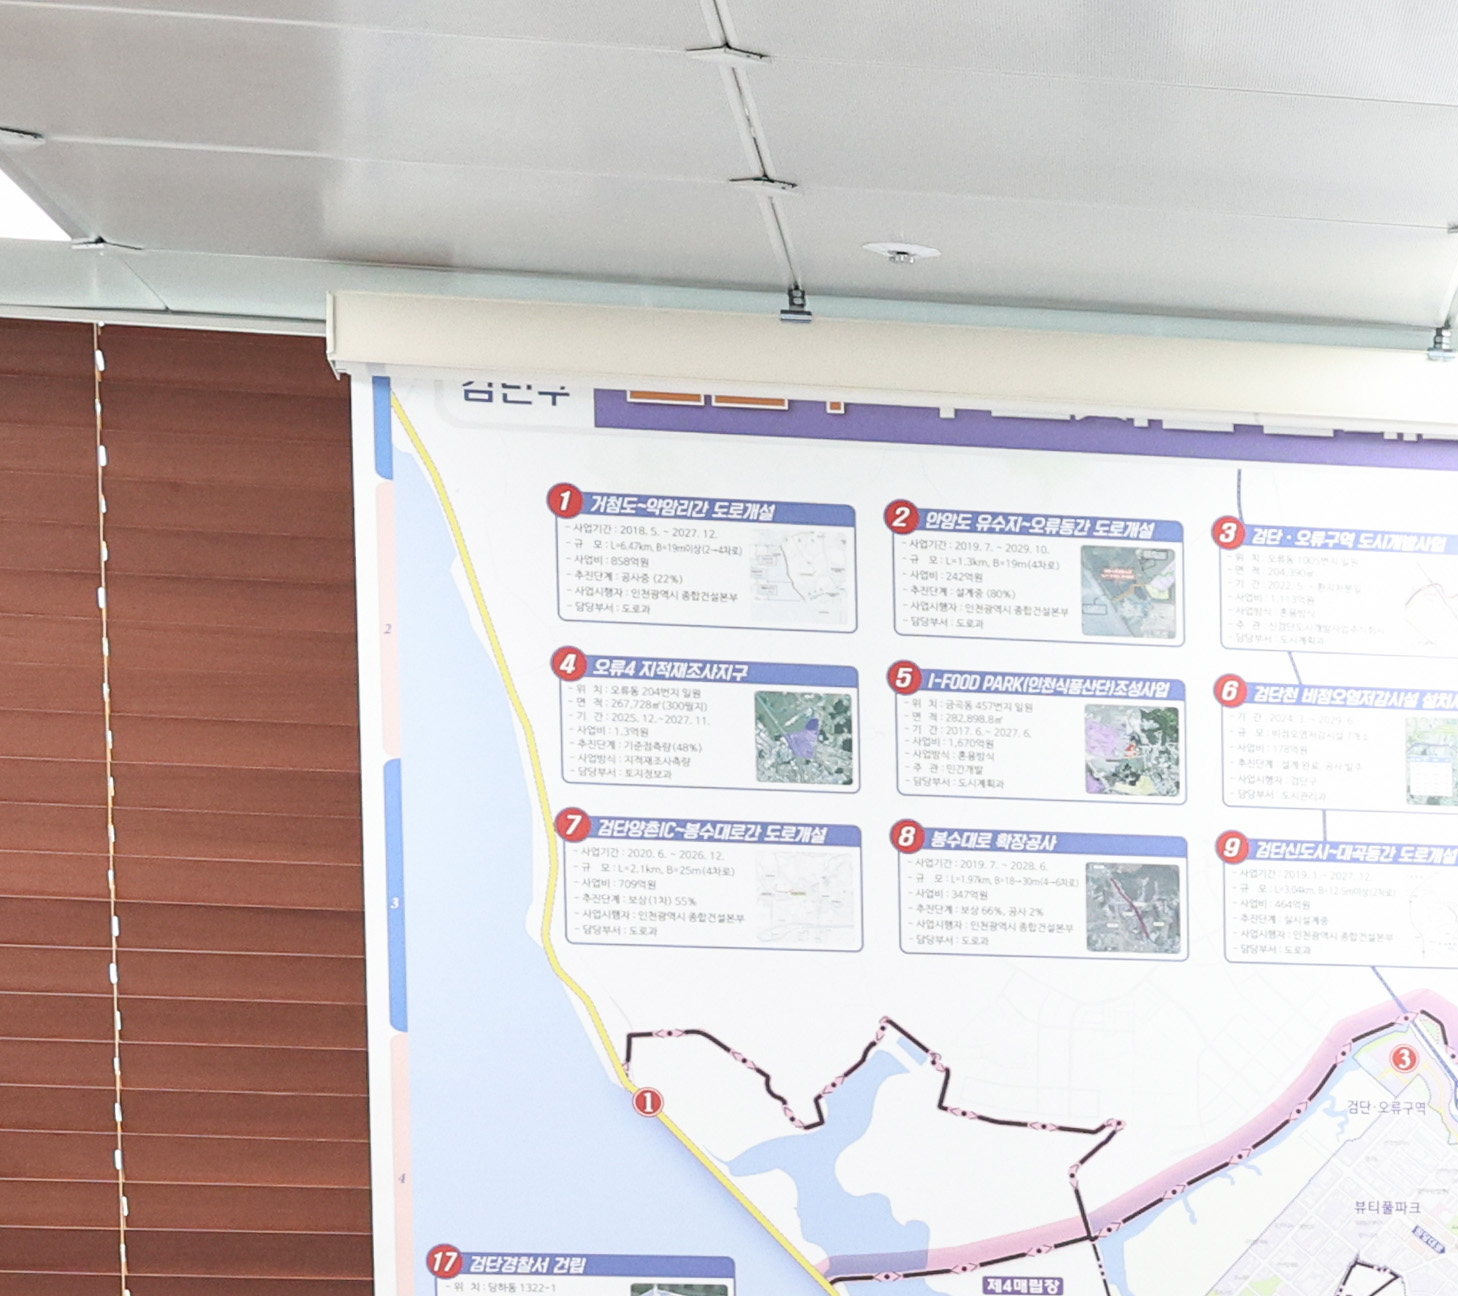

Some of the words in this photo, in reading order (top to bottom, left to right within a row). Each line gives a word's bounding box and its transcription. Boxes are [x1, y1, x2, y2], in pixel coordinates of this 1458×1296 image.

[561, 490, 571, 510] 1
[712, 501, 776, 521] 도로개설
[892, 507, 910, 527] 2
[926, 511, 971, 530] 안암도
[977, 513, 1091, 535] 유수지~오류동간
[1093, 520, 1155, 539] 도로개설
[1220, 522, 1237, 542] 3
[1252, 527, 1283, 545] 검단
[1293, 529, 1356, 549] 오류구역
[1358, 533, 1447, 553] 도시개발사업
[560, 653, 576, 674] 4
[592, 658, 635, 677] 오류4
[642, 660, 748, 681] 지적재조사지구
[895, 667, 913, 688] 5
[928, 672, 980, 691] I-FOOD
[1222, 681, 1239, 702] 6
[1254, 685, 1300, 703] 검단천
[566, 815, 582, 834] 7
[766, 825, 828, 843] 도로개설
[898, 826, 916, 847] 8
[931, 831, 991, 849] 봉수대로
[996, 833, 1057, 851] 확장공사
[1223, 837, 1240, 857] 9
[1400, 846, 1458, 864] 도로개설
[1354, 1200, 1421, 1215] 뷰티풀파크
[434, 1253, 458, 1272] 17
[470, 1255, 550, 1274] 검단경찰서
[553, 1257, 587, 1274] 건립
[987, 1278, 1060, 1294] 제4매립장
